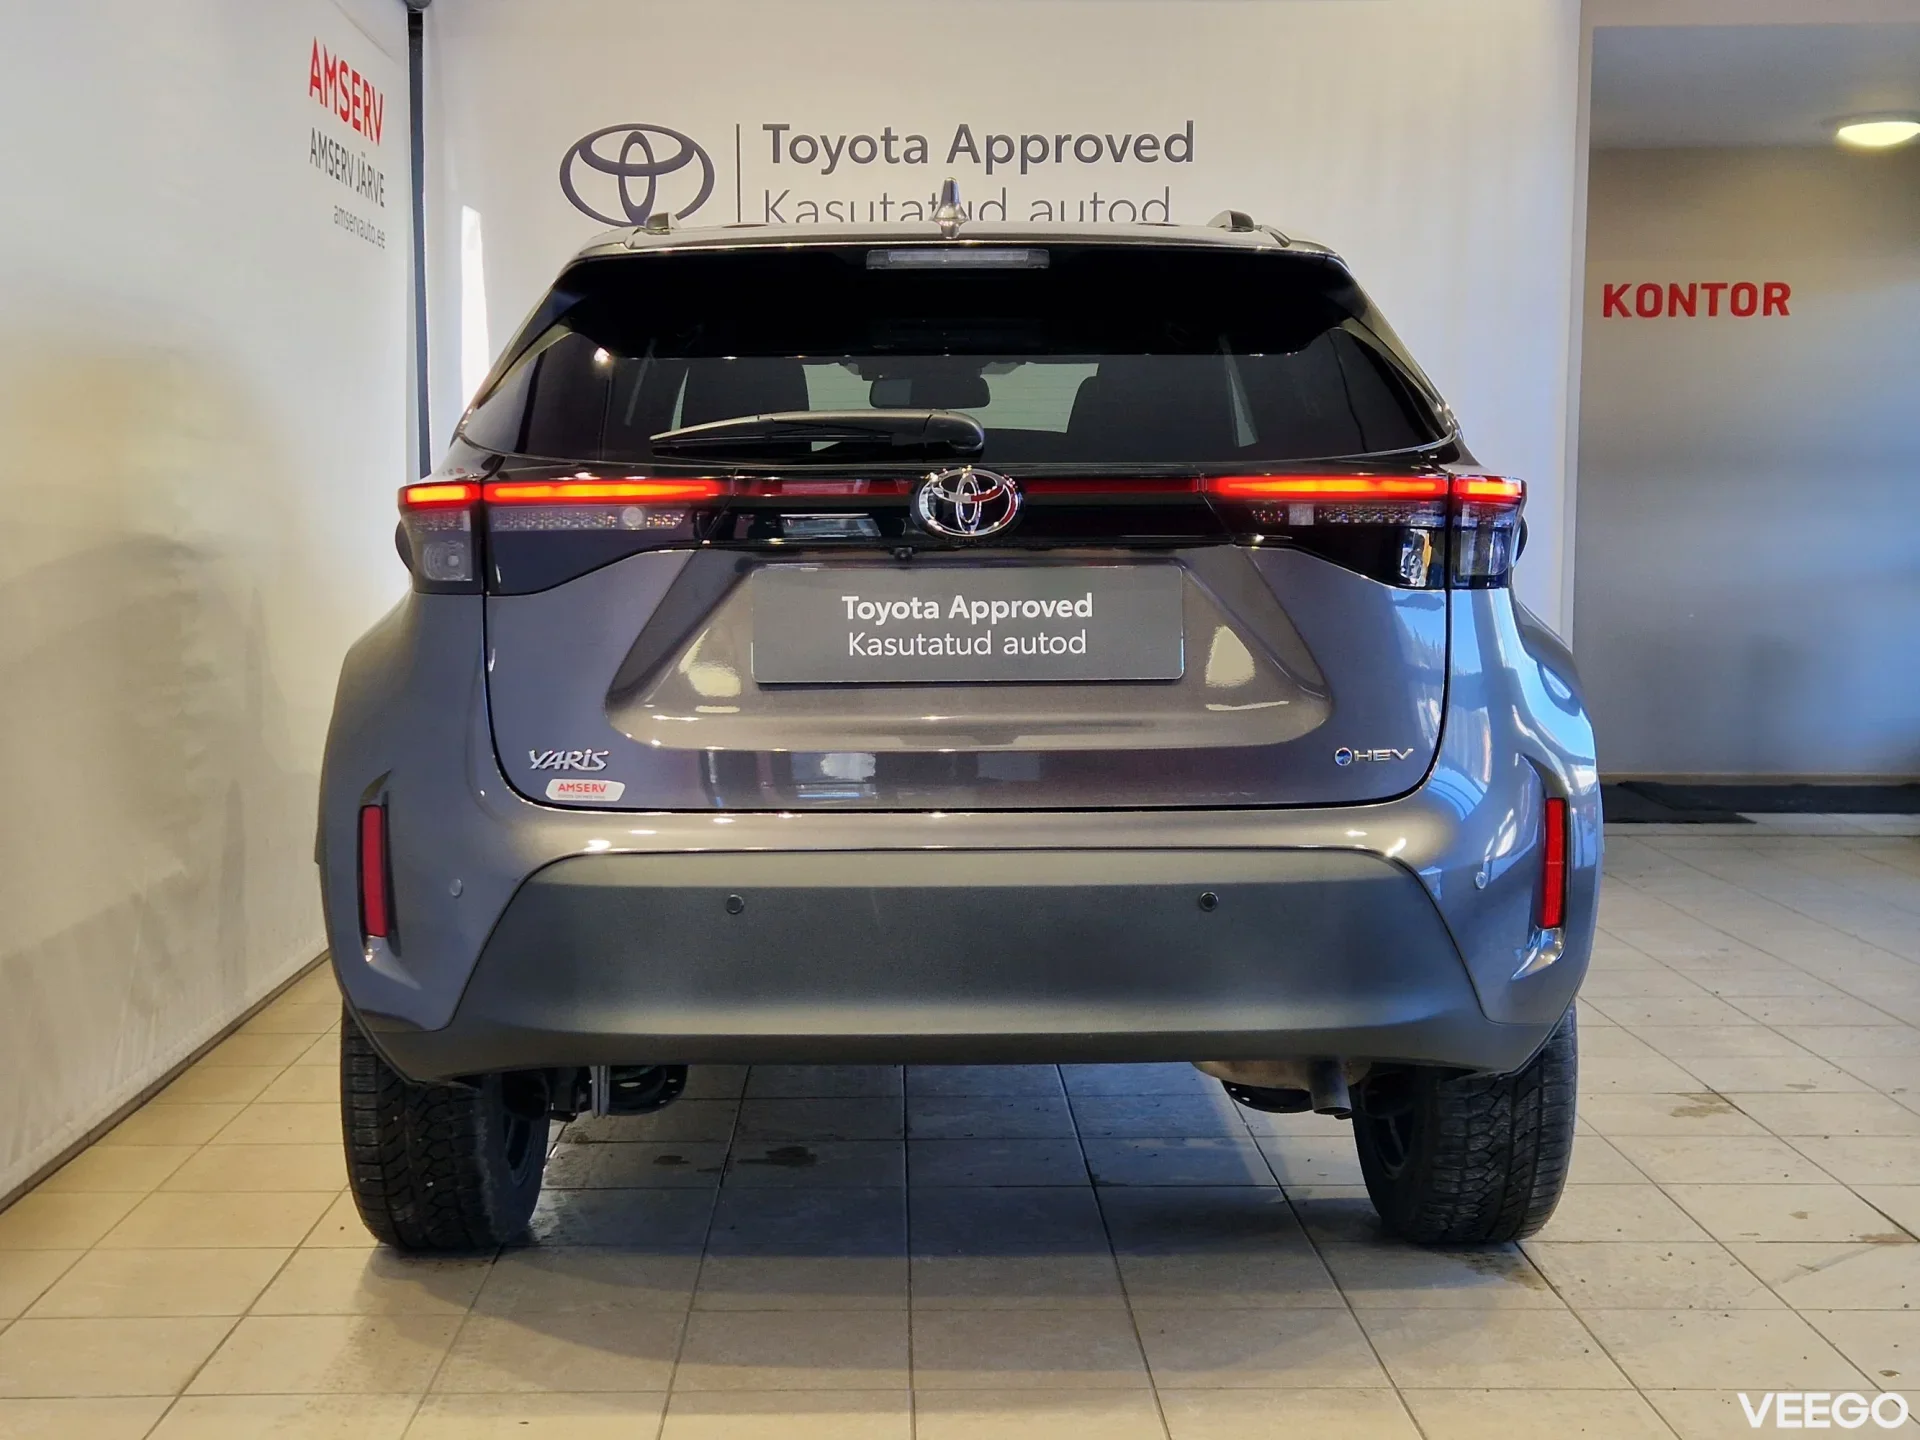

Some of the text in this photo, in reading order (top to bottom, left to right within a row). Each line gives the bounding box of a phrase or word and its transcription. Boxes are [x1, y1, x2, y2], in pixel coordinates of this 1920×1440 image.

[309, 36, 384, 146] AMSERV
[763, 119, 1194, 176] Toyota Approved
[309, 127, 385, 207] AMSERV JÄRVE
[1030, 186, 1170, 222] autod
[333, 204, 386, 249] amservauto.ee
[1603, 281, 1791, 318] KONTOR
[842, 593, 1093, 625] Toyota Approved
[848, 629, 1087, 656] Kasutatud autod
[558, 783, 607, 793] AMSERV
